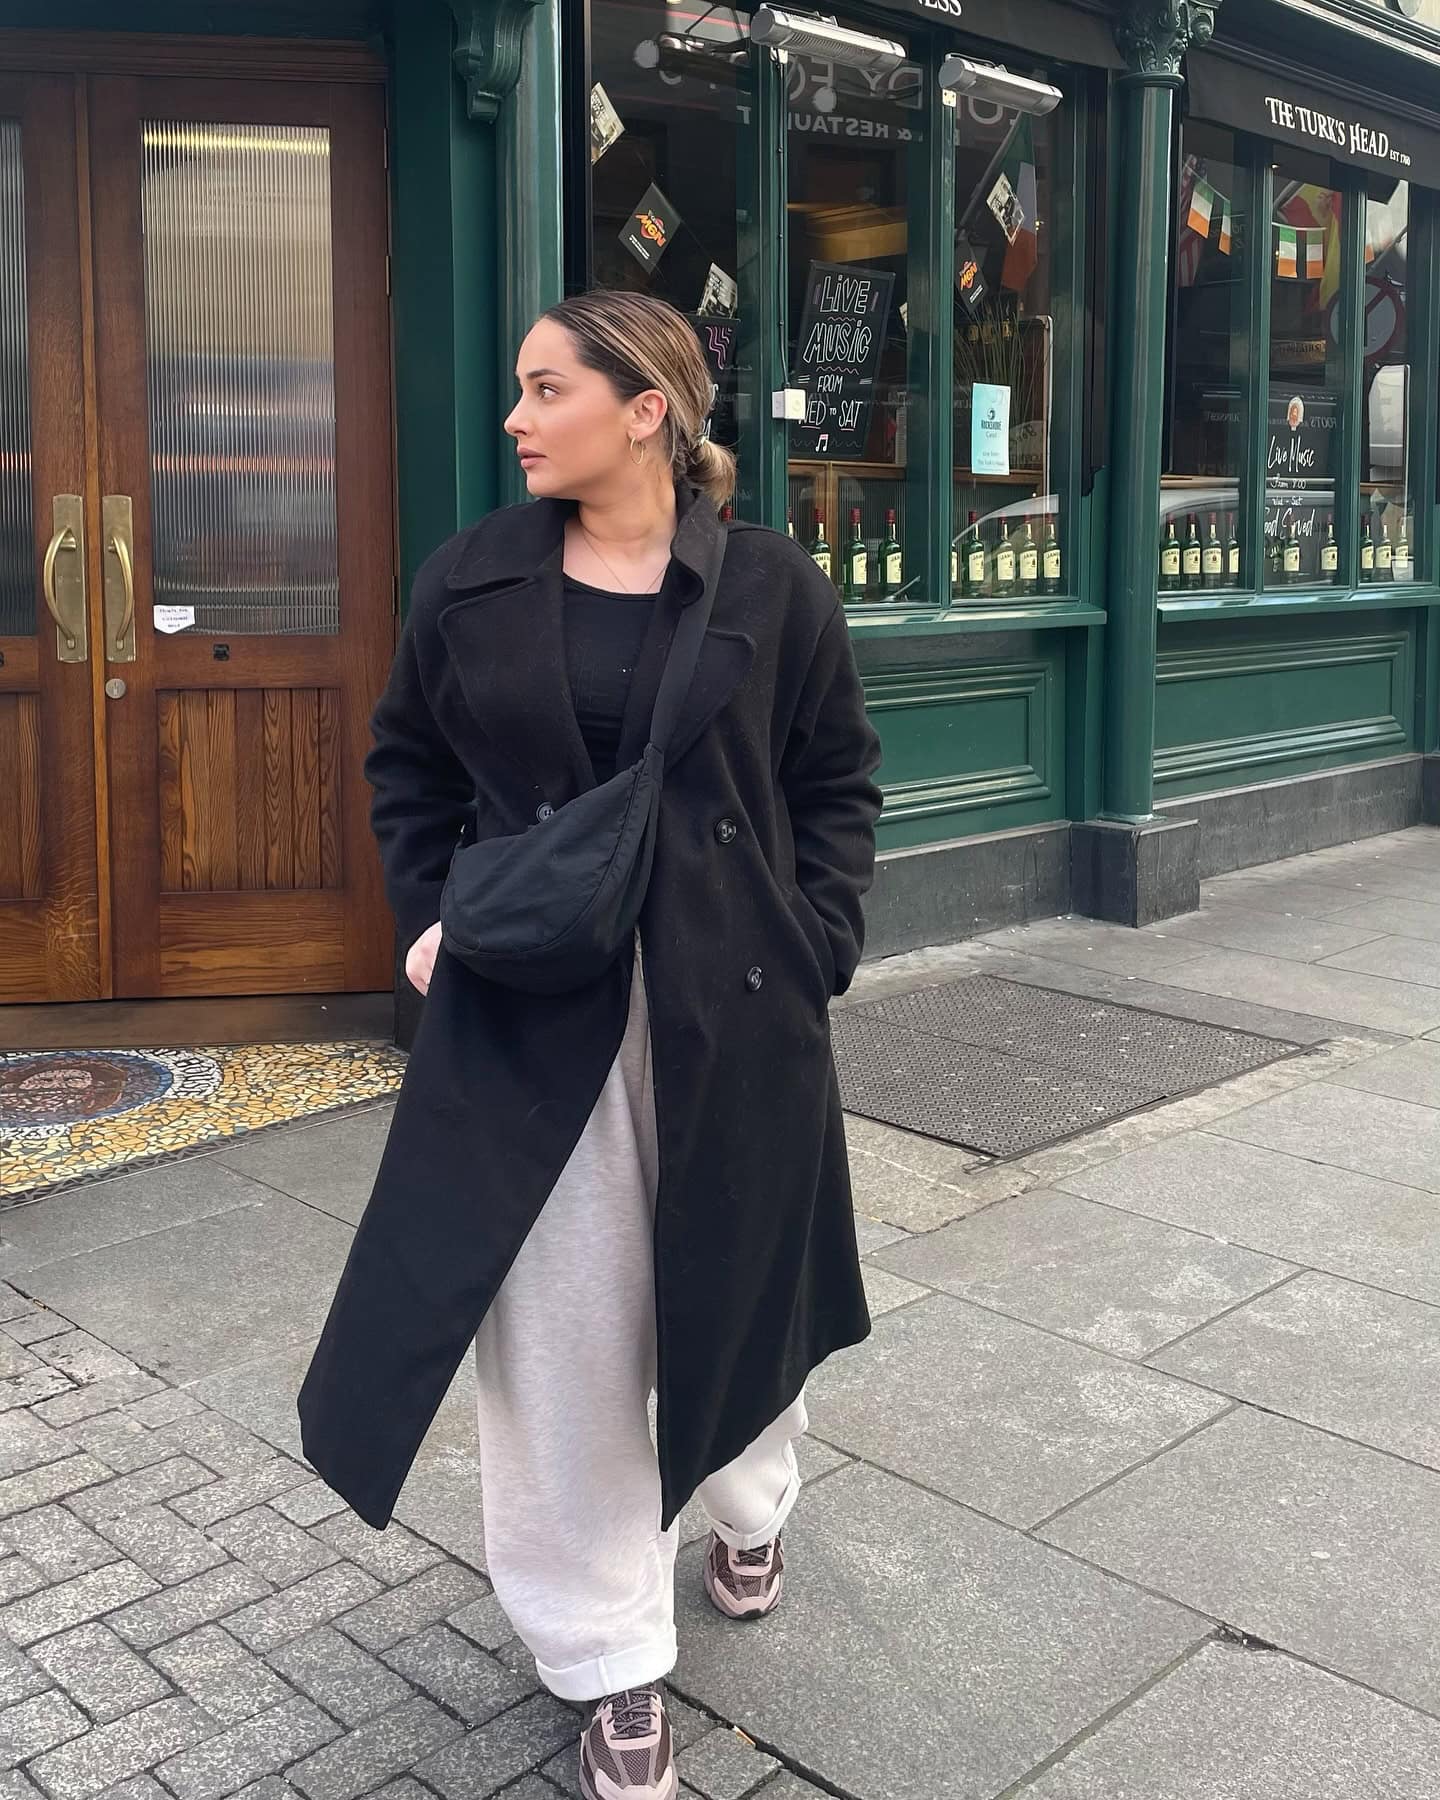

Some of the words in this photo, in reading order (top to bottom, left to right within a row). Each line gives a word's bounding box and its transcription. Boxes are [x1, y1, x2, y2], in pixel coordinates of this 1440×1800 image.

[1264, 96, 1296, 129] THE
[1295, 106, 1346, 146] TURK'S
[1349, 122, 1389, 158] HEAD
[1389, 149, 1400, 162] EST
[817, 374, 844, 395] FROM
[839, 400, 864, 429] SAT
[1267, 435, 1288, 469] Live
[1288, 435, 1315, 472] Music
